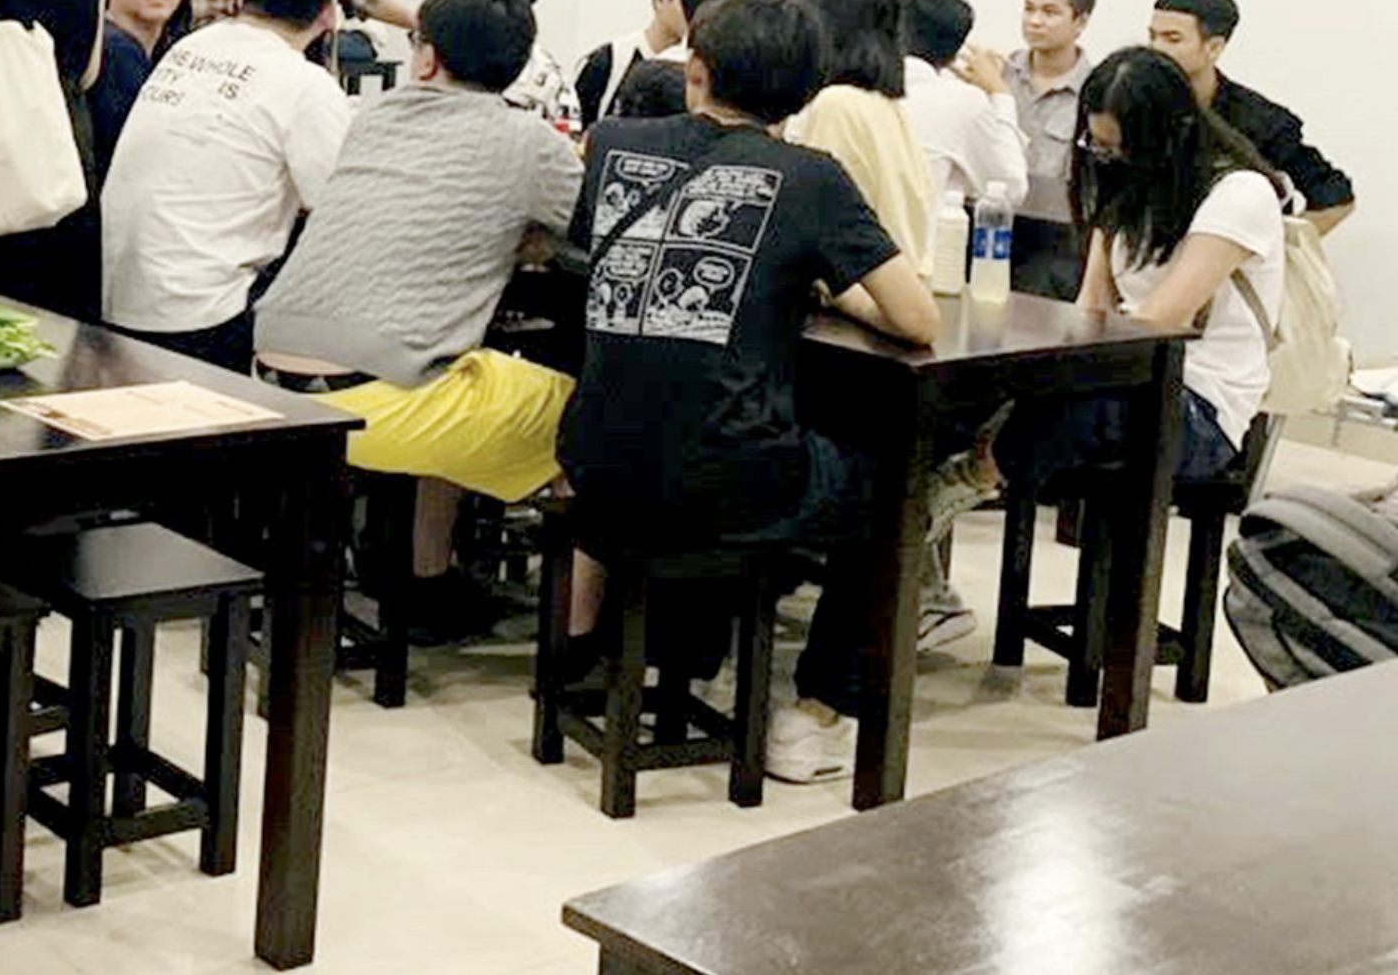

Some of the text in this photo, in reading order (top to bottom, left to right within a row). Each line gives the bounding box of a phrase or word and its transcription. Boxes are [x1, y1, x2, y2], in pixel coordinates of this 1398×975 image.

[188, 55, 257, 83] WHOLE
[141, 84, 186, 107] OURS
[217, 80, 240, 100] IS
